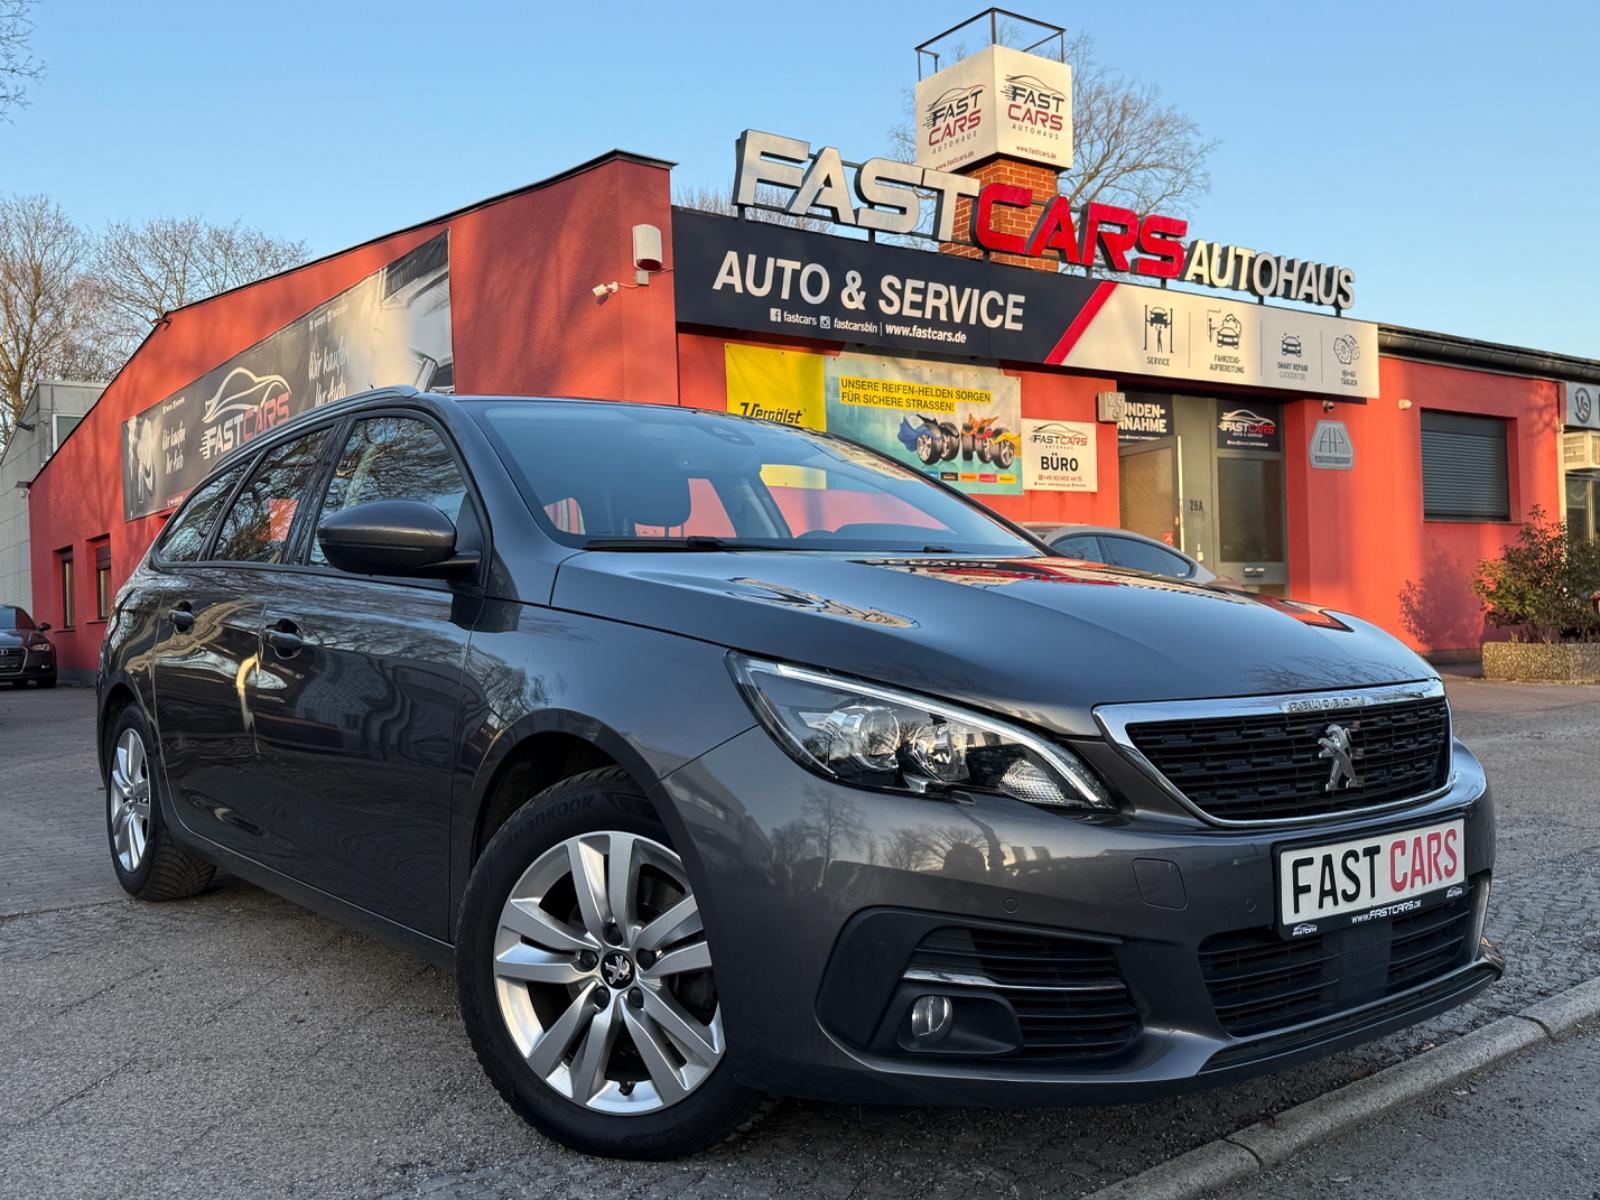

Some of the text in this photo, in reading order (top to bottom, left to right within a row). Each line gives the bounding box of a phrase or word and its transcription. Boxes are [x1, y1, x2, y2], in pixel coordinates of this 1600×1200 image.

[931, 89, 983, 127] FAST
[1012, 85, 1064, 112] FAST
[928, 109, 981, 146] CARS
[1008, 104, 1063, 131] CARS
[1012, 123, 1059, 140] AUTOHAUS
[1184, 240, 1355, 311] AUTOHAUS
[713, 251, 1026, 331] AUTO & SERVICE
[783, 311, 817, 326] fastcars
[885, 323, 967, 343] www.fastcars.de
[1147, 356, 1170, 366] SERVICE
[841, 379, 991, 402] UNSERE REIFEN-HELDEN SORGEN
[841, 391, 954, 411] FÜR SICHERE STRASSEN!
[1117, 417, 1167, 433] NNAHME
[1041, 452, 1078, 471] BÜRO
[1289, 697, 1358, 711] PEUGEOT
[1292, 828, 1457, 914] FAST CARS
